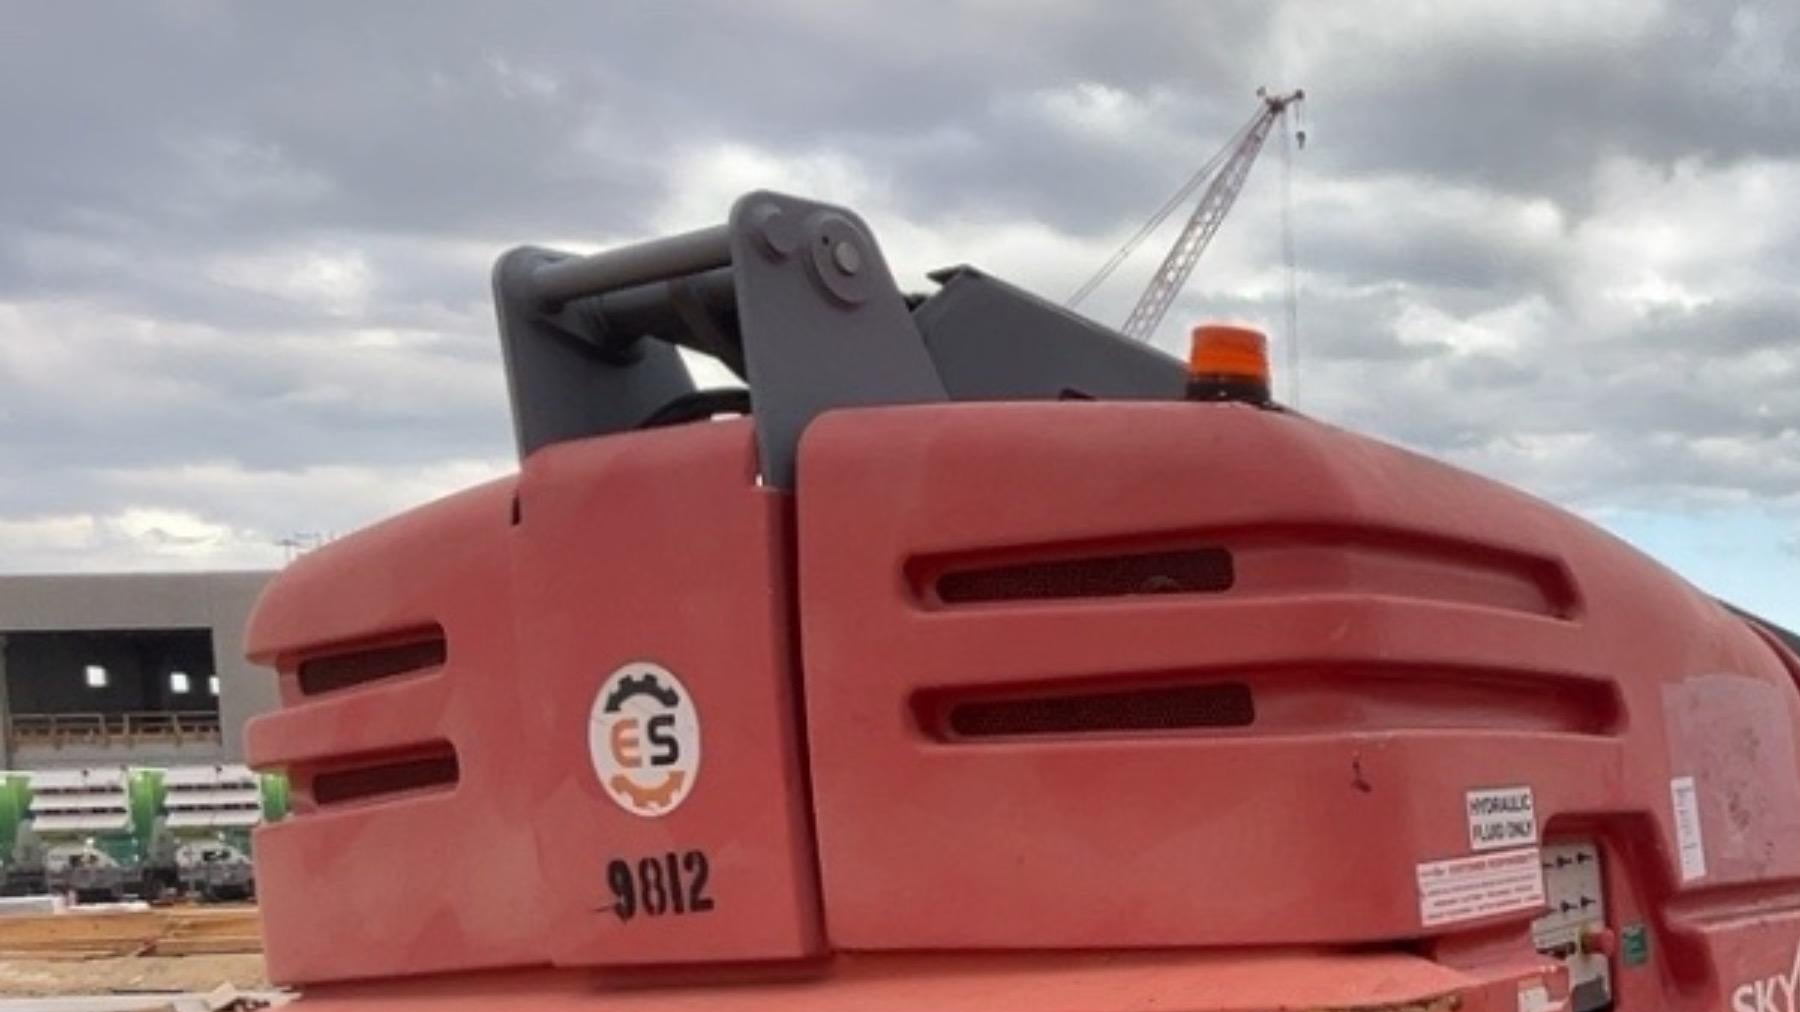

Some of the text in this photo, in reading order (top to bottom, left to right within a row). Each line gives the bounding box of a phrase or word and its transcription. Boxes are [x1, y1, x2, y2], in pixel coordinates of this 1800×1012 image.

[609, 713, 680, 769] ES
[1470, 793, 1531, 816] HYDRAULIC
[1472, 820, 1531, 842] FLUID ONLY
[606, 849, 714, 922] 9812
